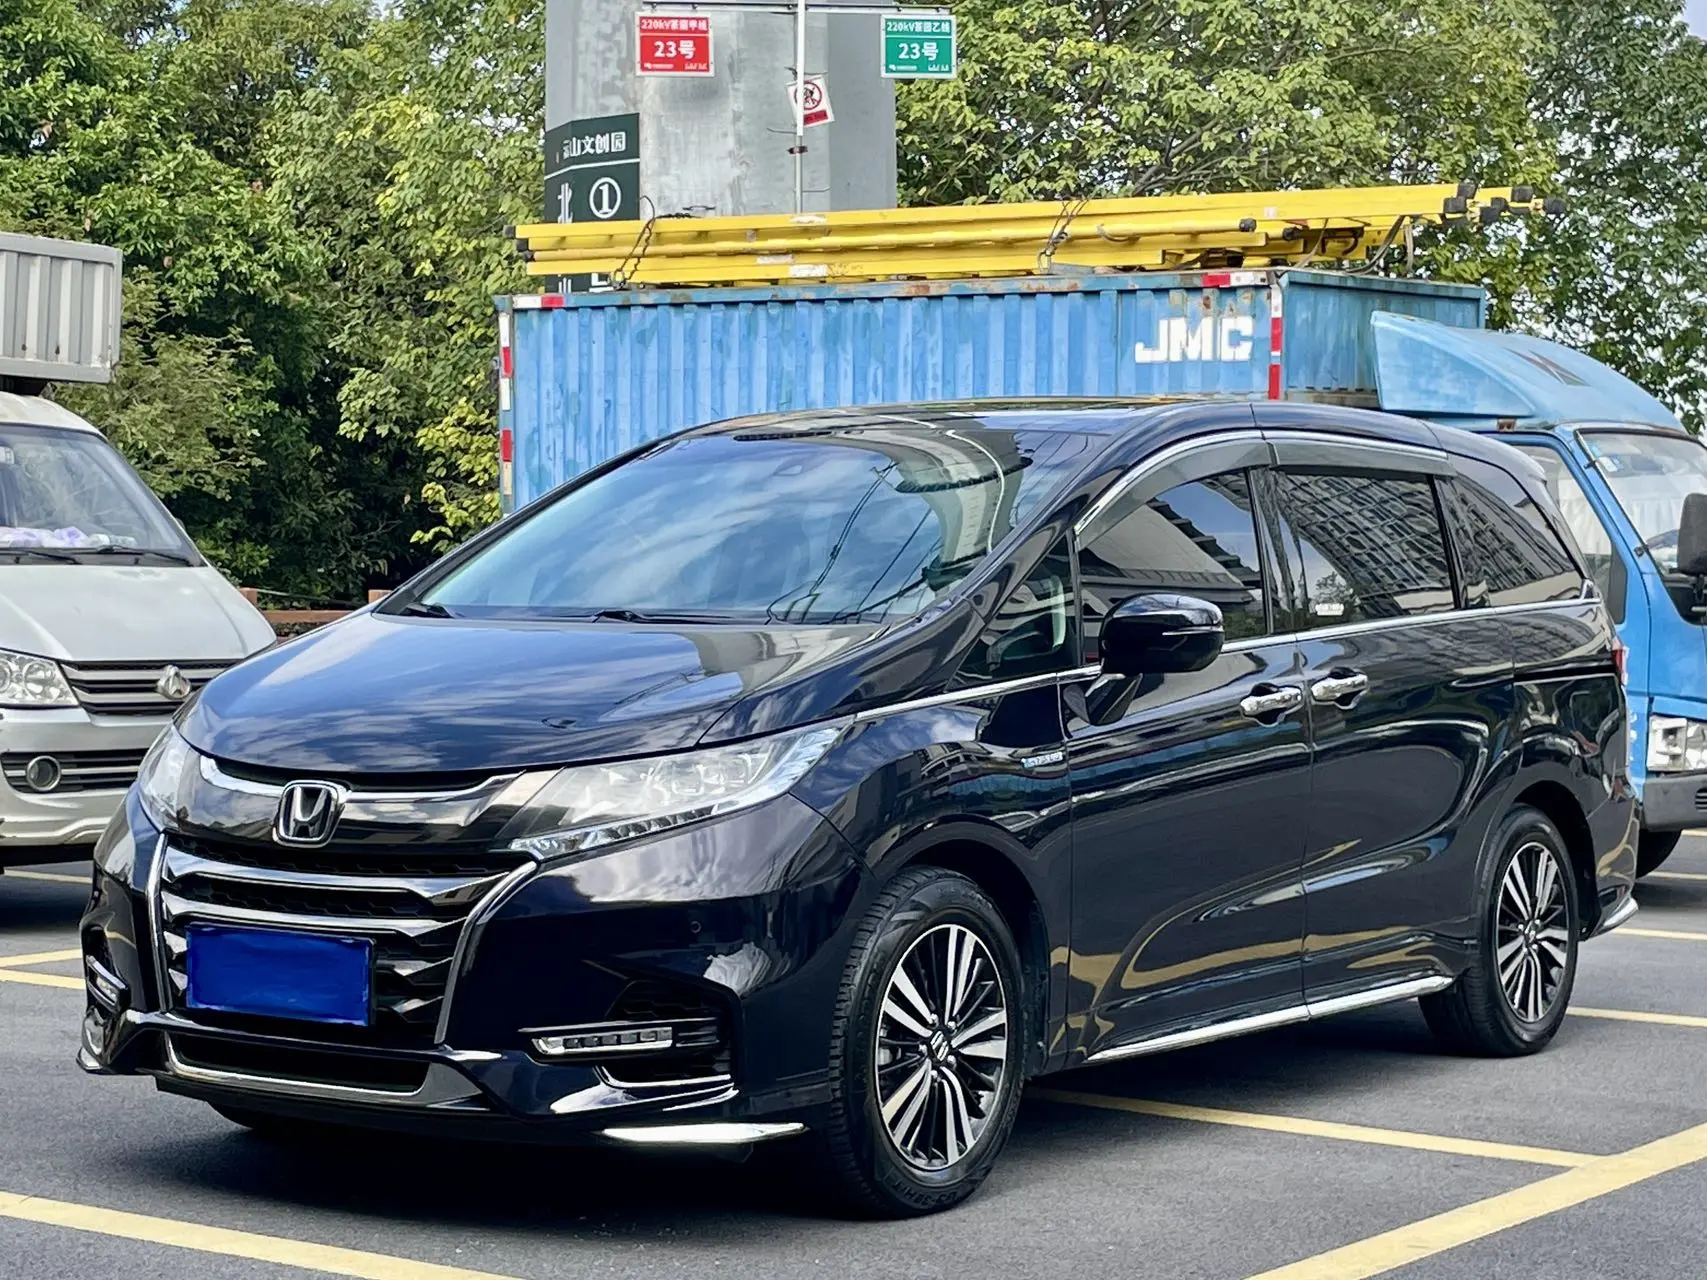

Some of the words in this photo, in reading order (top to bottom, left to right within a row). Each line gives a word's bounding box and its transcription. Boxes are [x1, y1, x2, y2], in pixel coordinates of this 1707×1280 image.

[653, 39, 696, 59] 23号
[898, 41, 939, 61] 23号
[1135, 316, 1253, 363] JMC
